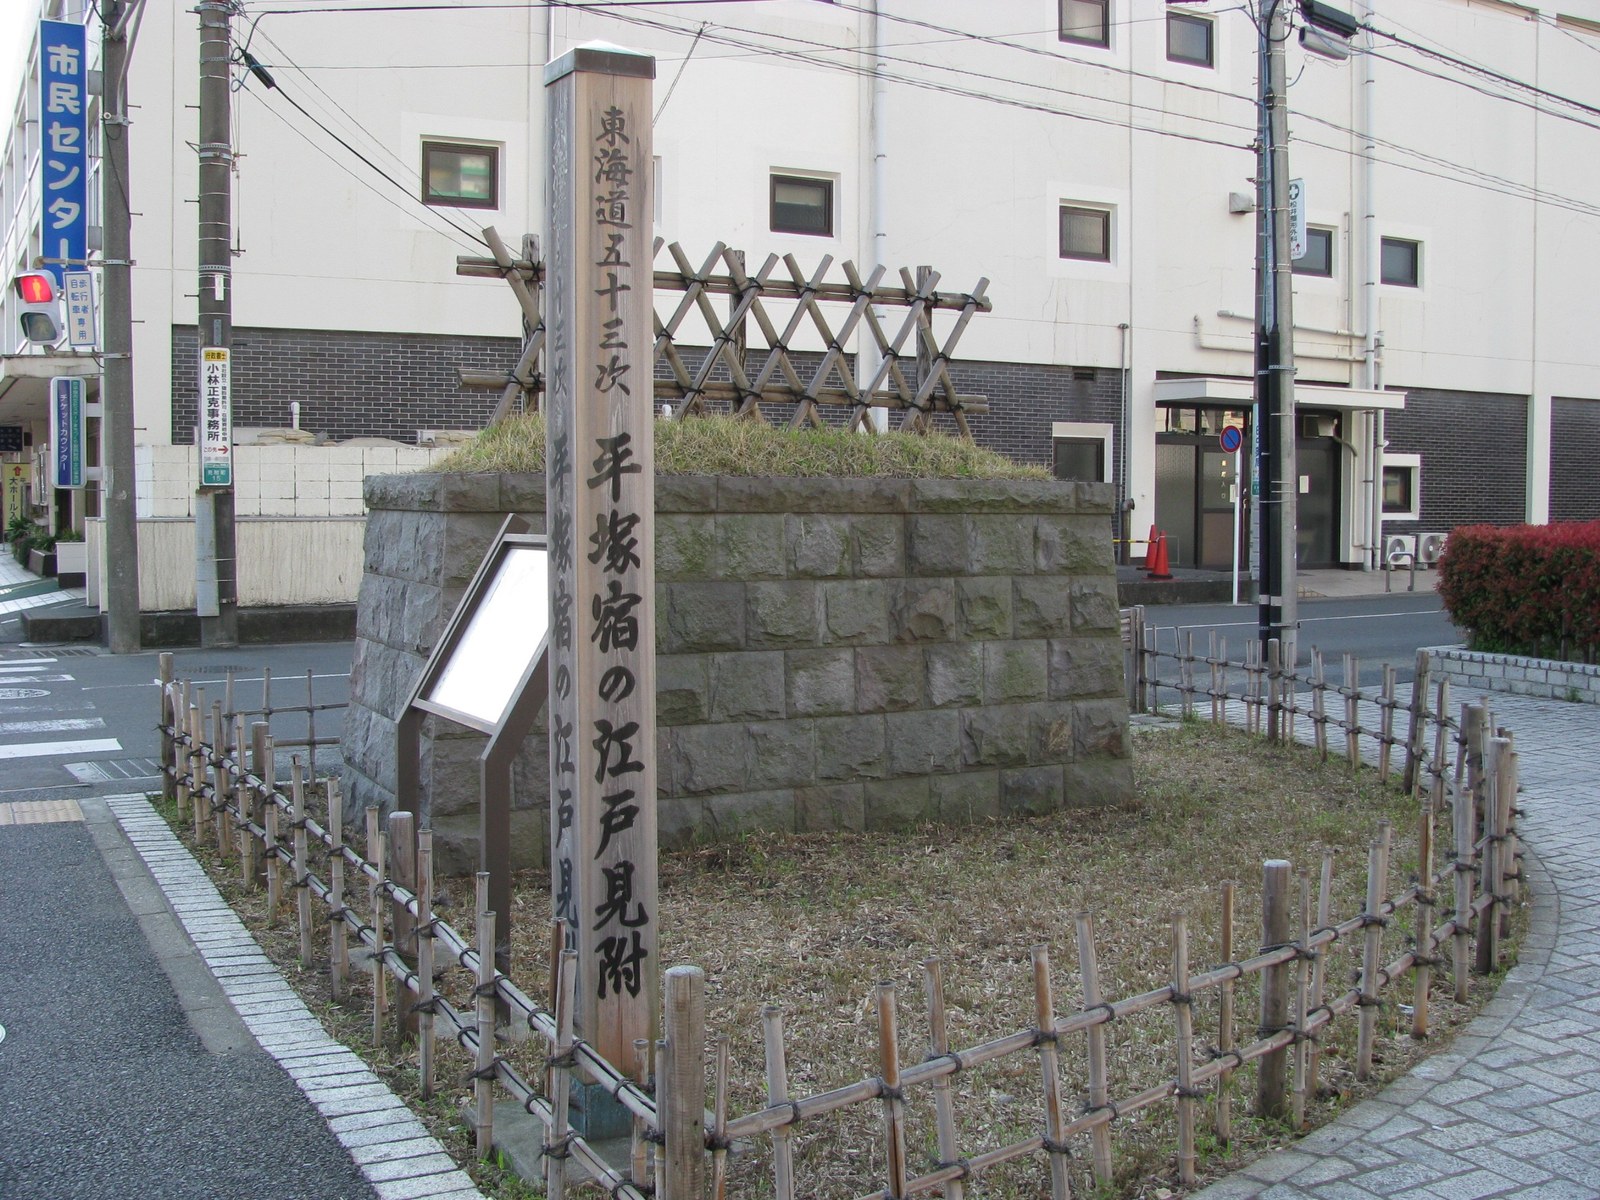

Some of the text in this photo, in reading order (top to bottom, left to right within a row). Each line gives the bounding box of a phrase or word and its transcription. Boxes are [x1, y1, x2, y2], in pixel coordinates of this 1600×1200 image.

[47, 45, 81, 268] 市民センター
[70, 279, 81, 314] 自転車
[79, 279, 89, 314] 歩行者
[60, 394, 69, 471] チケットカウンター
[207, 363, 220, 442] 小林正克事務所
[586, 106, 649, 1000] 東海道五十三次 平塚宿の江戸見附
[550, 432, 579, 996] 平塚宿の江戸見
